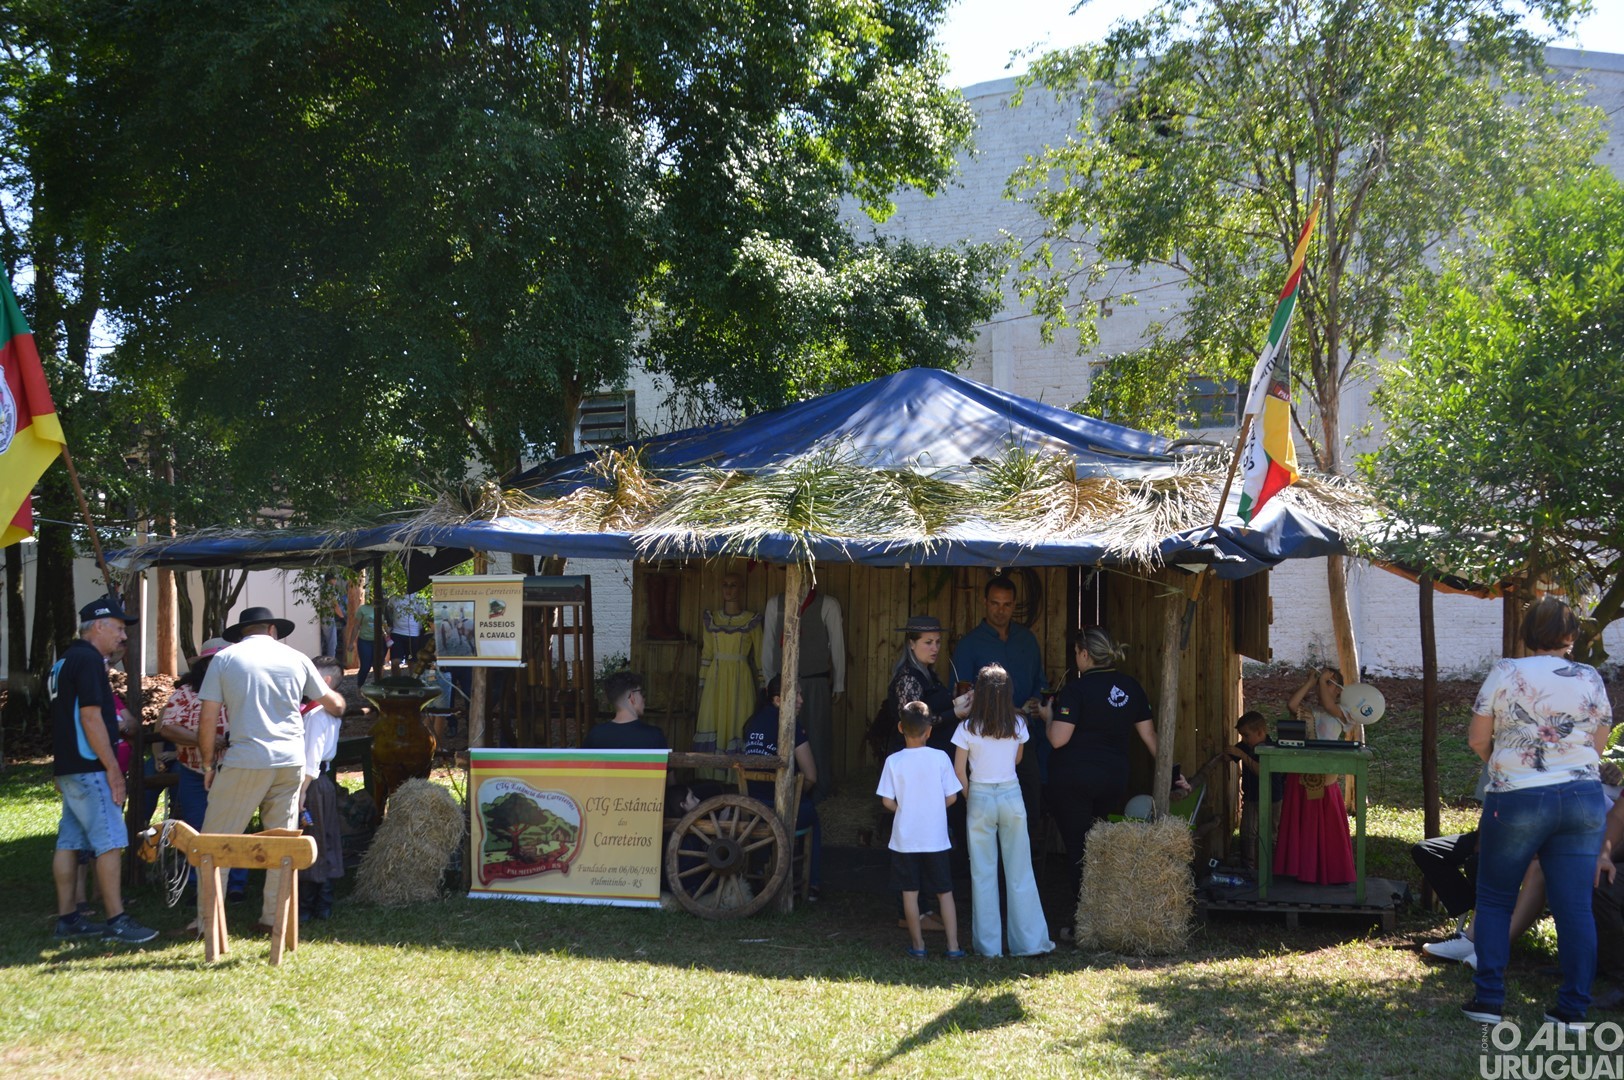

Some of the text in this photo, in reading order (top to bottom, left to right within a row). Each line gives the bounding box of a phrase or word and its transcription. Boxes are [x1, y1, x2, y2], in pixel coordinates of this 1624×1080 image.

[435, 588, 448, 597] CTG
[449, 588, 478, 596] Estância
[485, 588, 521, 596] Carreteiros
[496, 782, 510, 791] CTG
[511, 783, 536, 797] Estância
[546, 793, 576, 811] Carreteiros
[585, 796, 663, 816] CTG Estância
[617, 817, 628, 826] dos
[593, 831, 653, 847] Carreteiros
[577, 863, 658, 876] Fundado em 06/06/1985
[591, 876, 627, 887] Palmitinho
[632, 878, 643, 888] RS
